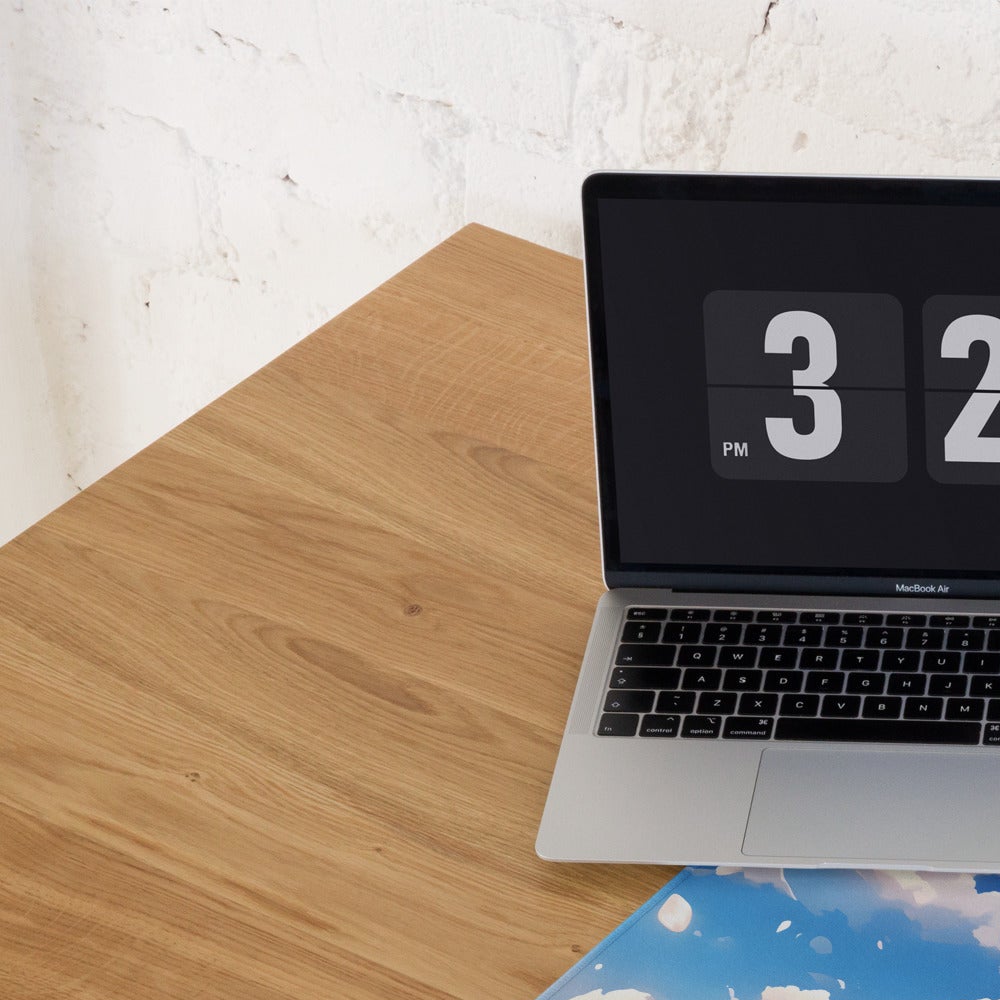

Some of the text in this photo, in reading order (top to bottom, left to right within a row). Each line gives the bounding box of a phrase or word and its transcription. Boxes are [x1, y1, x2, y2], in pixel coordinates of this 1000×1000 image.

[764, 310, 843, 461] 3
[722, 441, 749, 457] PM
[895, 583, 950, 593] MacBook Air
[689, 728, 714, 736] option
